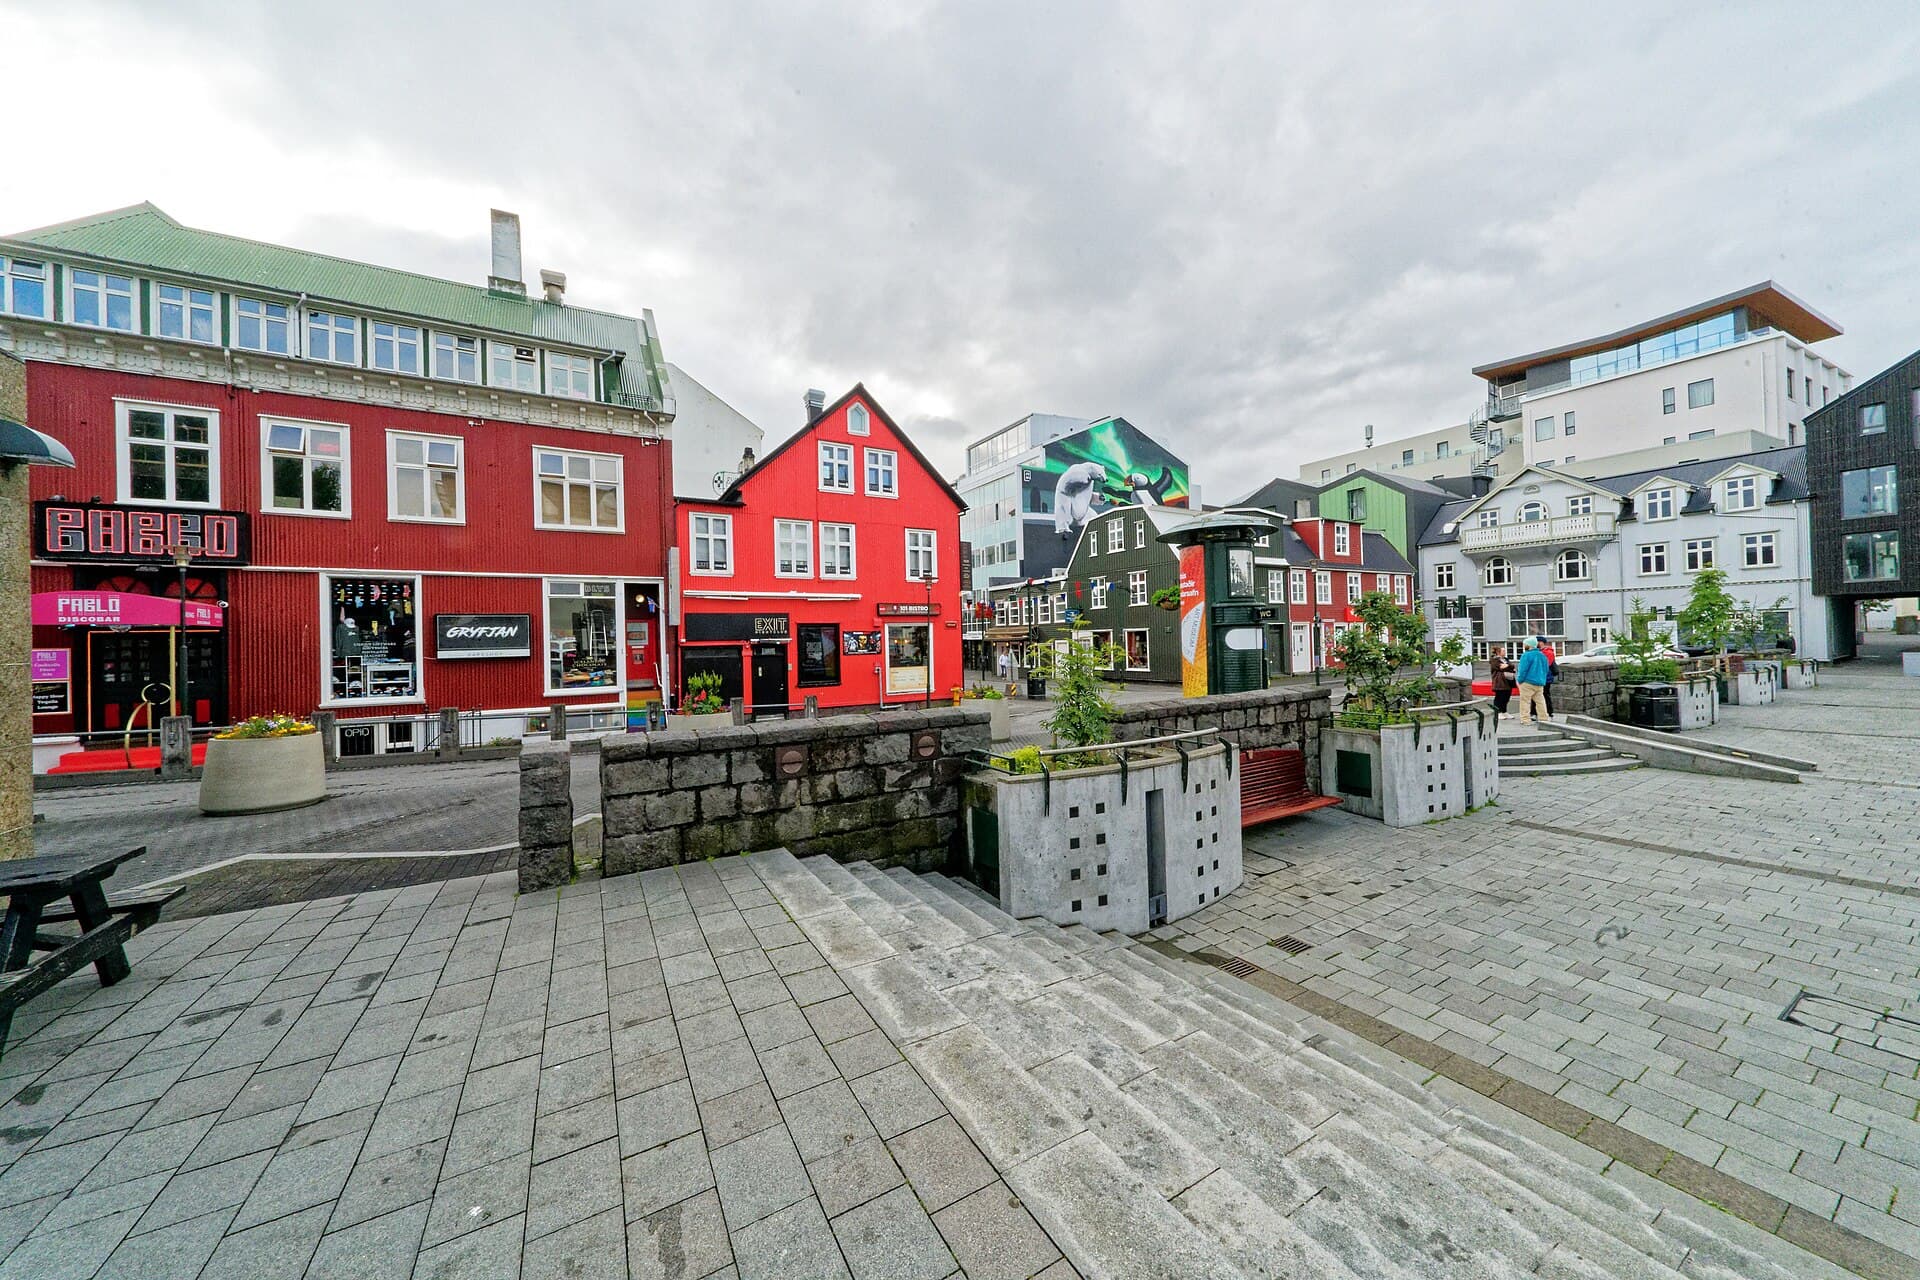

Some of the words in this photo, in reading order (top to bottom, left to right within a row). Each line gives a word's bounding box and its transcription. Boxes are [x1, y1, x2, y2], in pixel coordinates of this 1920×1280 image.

[58, 597, 120, 612] PABLO
[755, 618, 788, 630] EXIT
[446, 625, 518, 638] GRYFJAN
